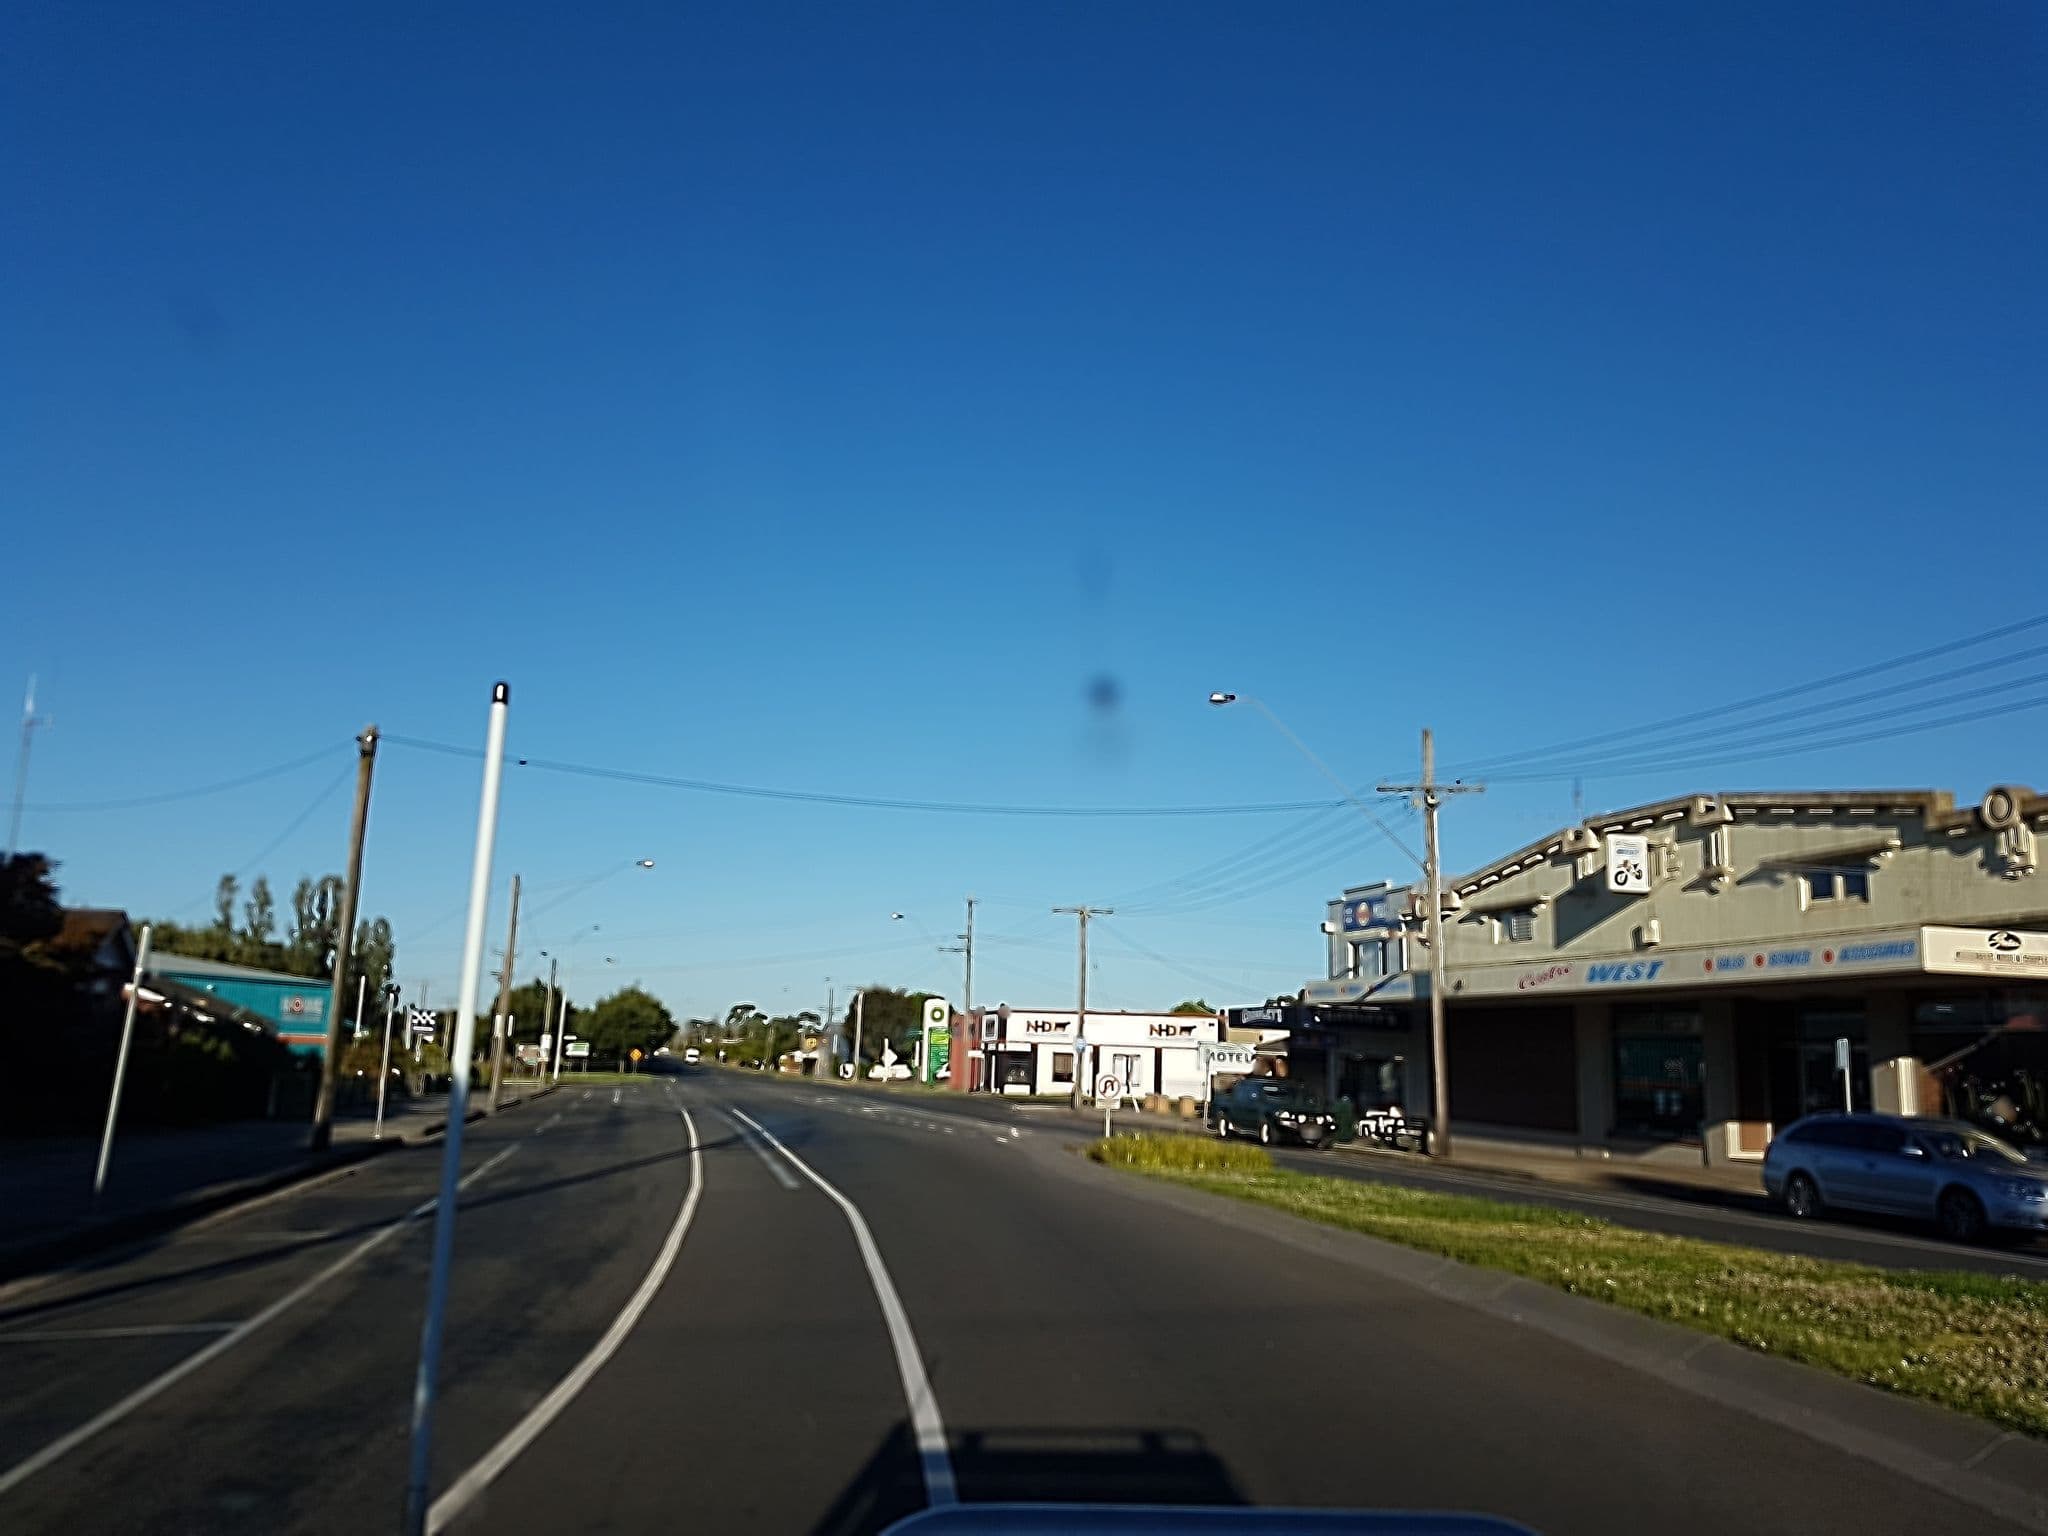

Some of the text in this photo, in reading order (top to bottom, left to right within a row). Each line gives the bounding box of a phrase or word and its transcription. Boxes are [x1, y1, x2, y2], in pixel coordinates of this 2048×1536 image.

[1587, 960, 1664, 983] WEST
[1026, 1020, 1052, 1033] NHD
[1150, 1024, 1176, 1037] NHD
